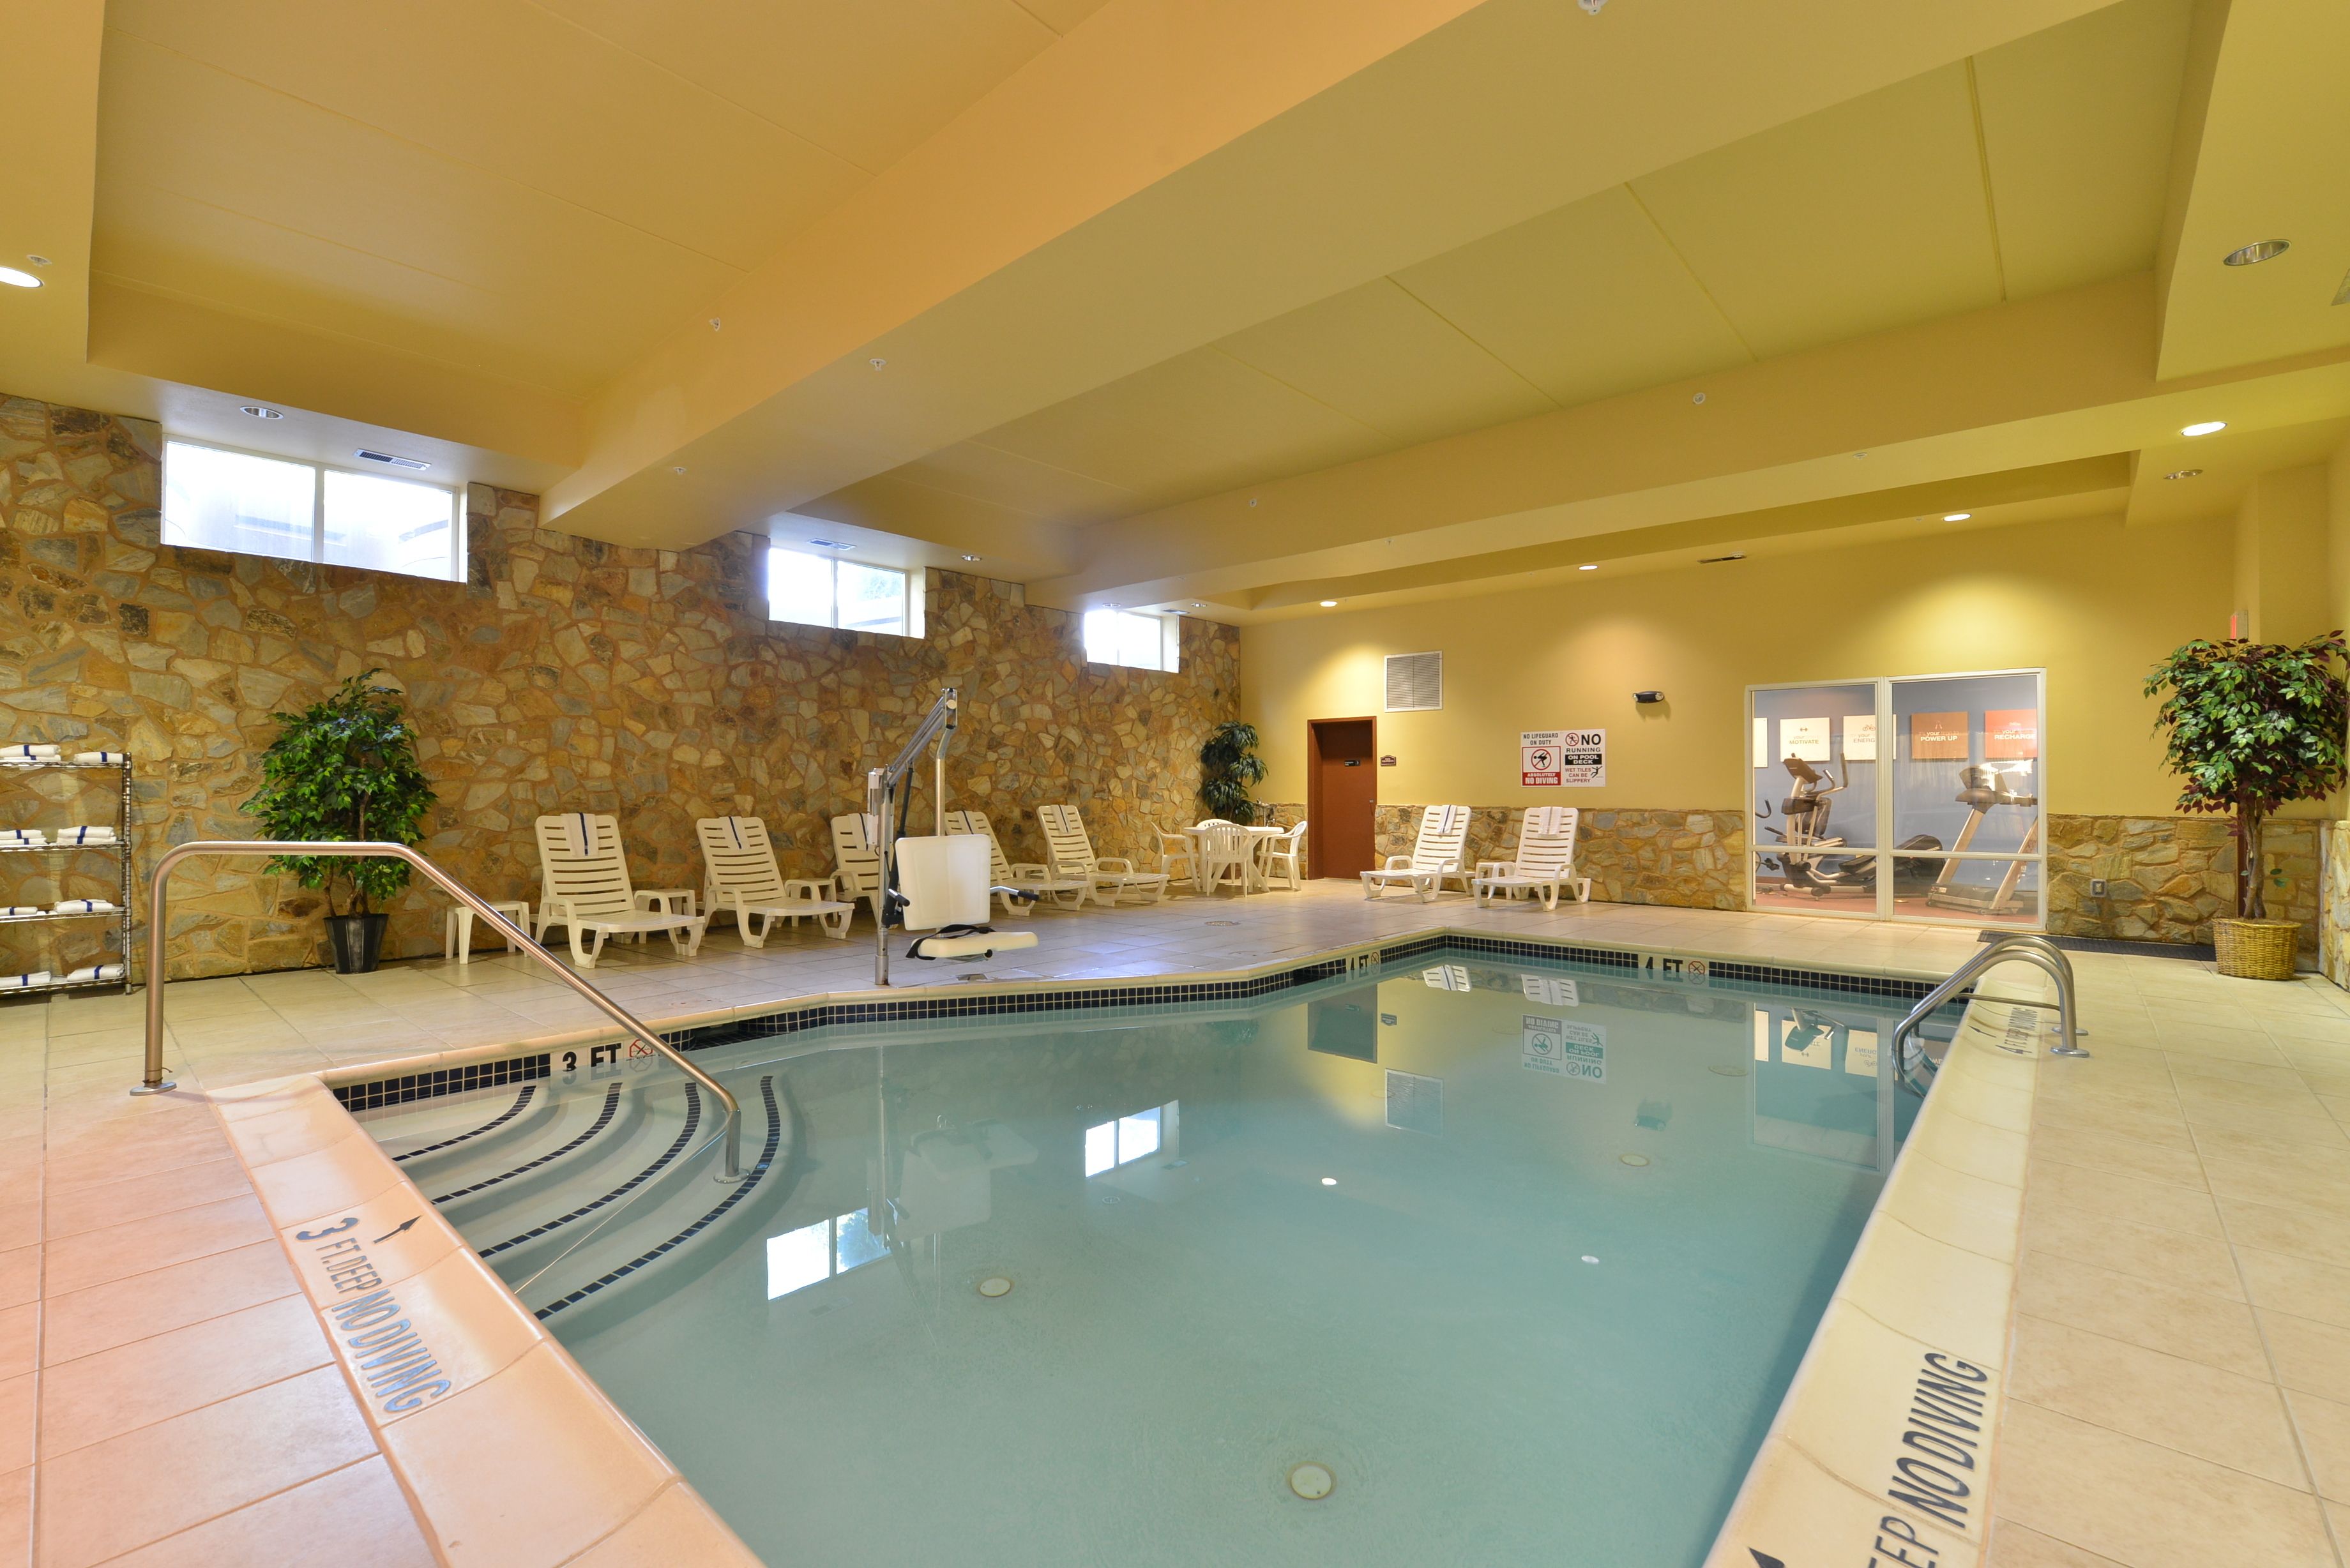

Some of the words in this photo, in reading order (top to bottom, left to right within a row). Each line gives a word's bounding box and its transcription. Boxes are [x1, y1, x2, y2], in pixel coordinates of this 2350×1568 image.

[1581, 734, 1602, 746] NO
[1358, 954, 1368, 969] FT
[1663, 958, 1683, 972] FT
[562, 1051, 577, 1072] 3
[591, 1043, 622, 1067] FT
[296, 1217, 360, 1240] 3
[326, 1255, 383, 1293] DEEP
[331, 1288, 401, 1331] NO
[348, 1318, 451, 1412] DIVING
[1902, 1352, 1987, 1472] DIVING
[1888, 1457, 1970, 1529] NO
[1868, 1516, 1939, 1568] EP
